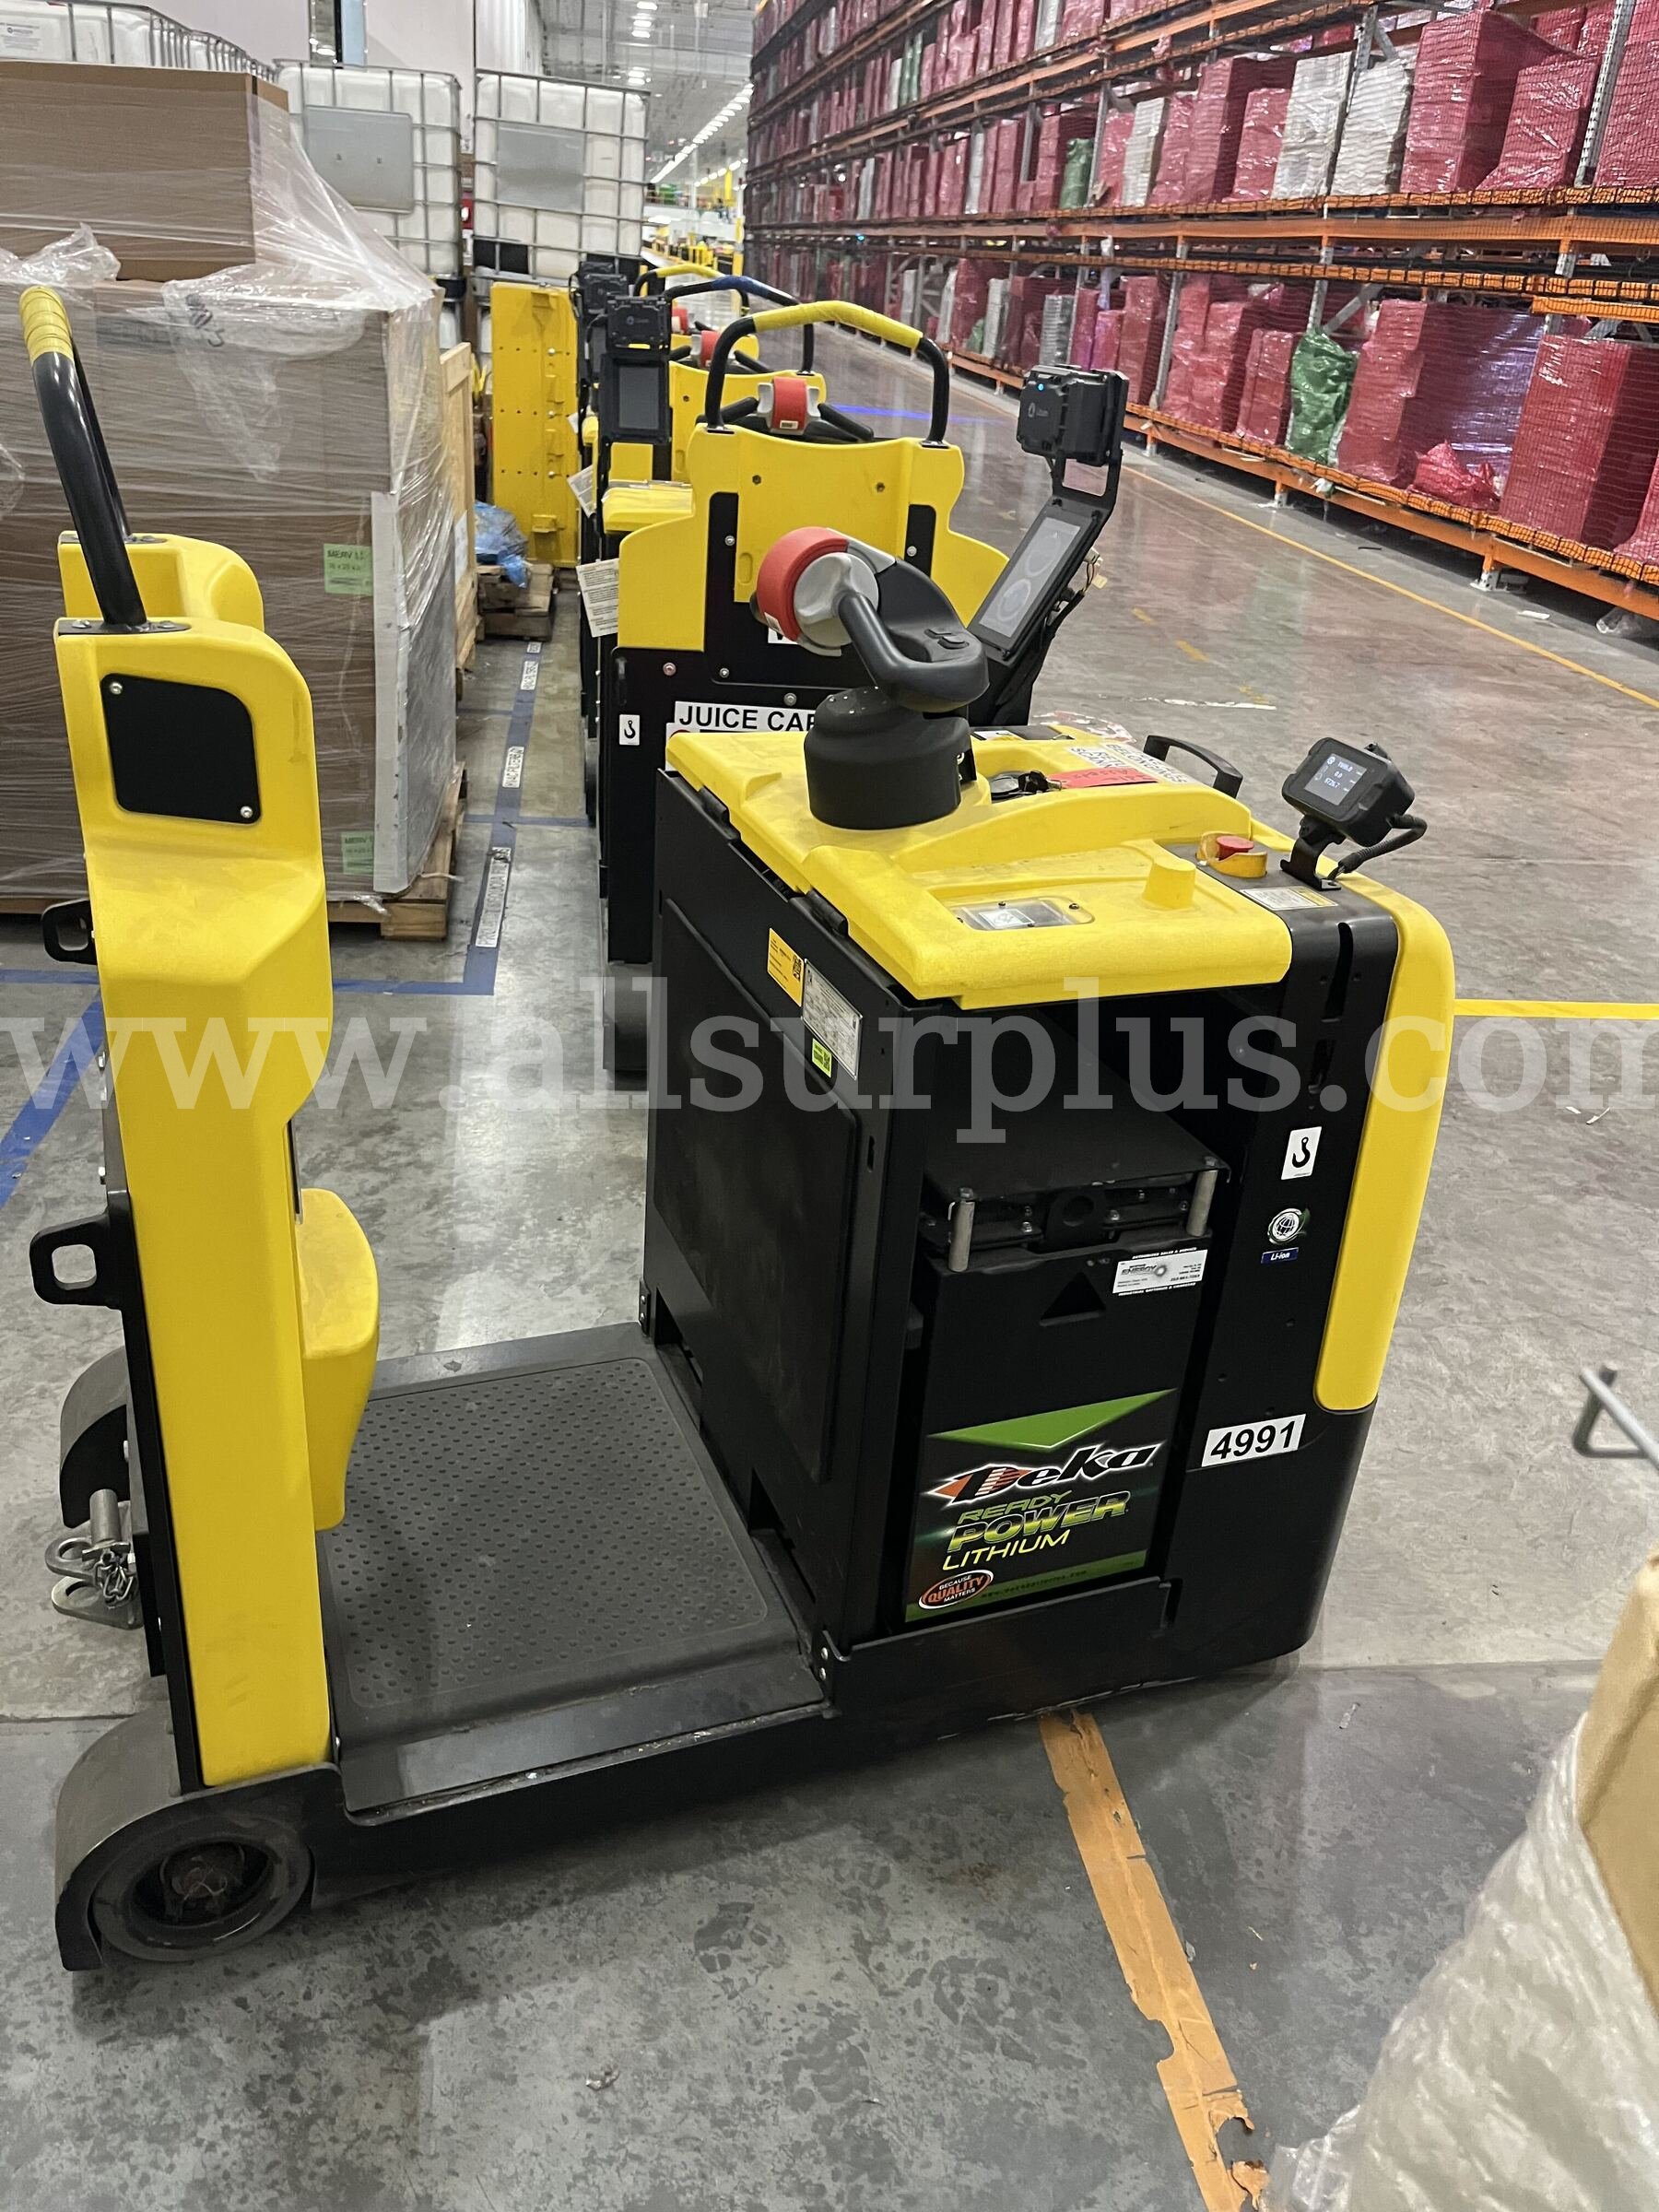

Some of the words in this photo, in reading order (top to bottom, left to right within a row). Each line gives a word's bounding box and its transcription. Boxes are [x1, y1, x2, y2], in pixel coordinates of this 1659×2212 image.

[679, 706, 758, 730] JUICE
[1210, 1420, 1296, 1459] 4991
[947, 1441, 1161, 1507] Deka
[947, 1490, 1131, 1553] POWER
[957, 1489, 1073, 1524] READY
[942, 1529, 1071, 1571] LITHIUM
[927, 1574, 984, 1603] QUALITY
[938, 1574, 972, 1591] BECAUSE
[943, 1587, 976, 1603] MATTERS
